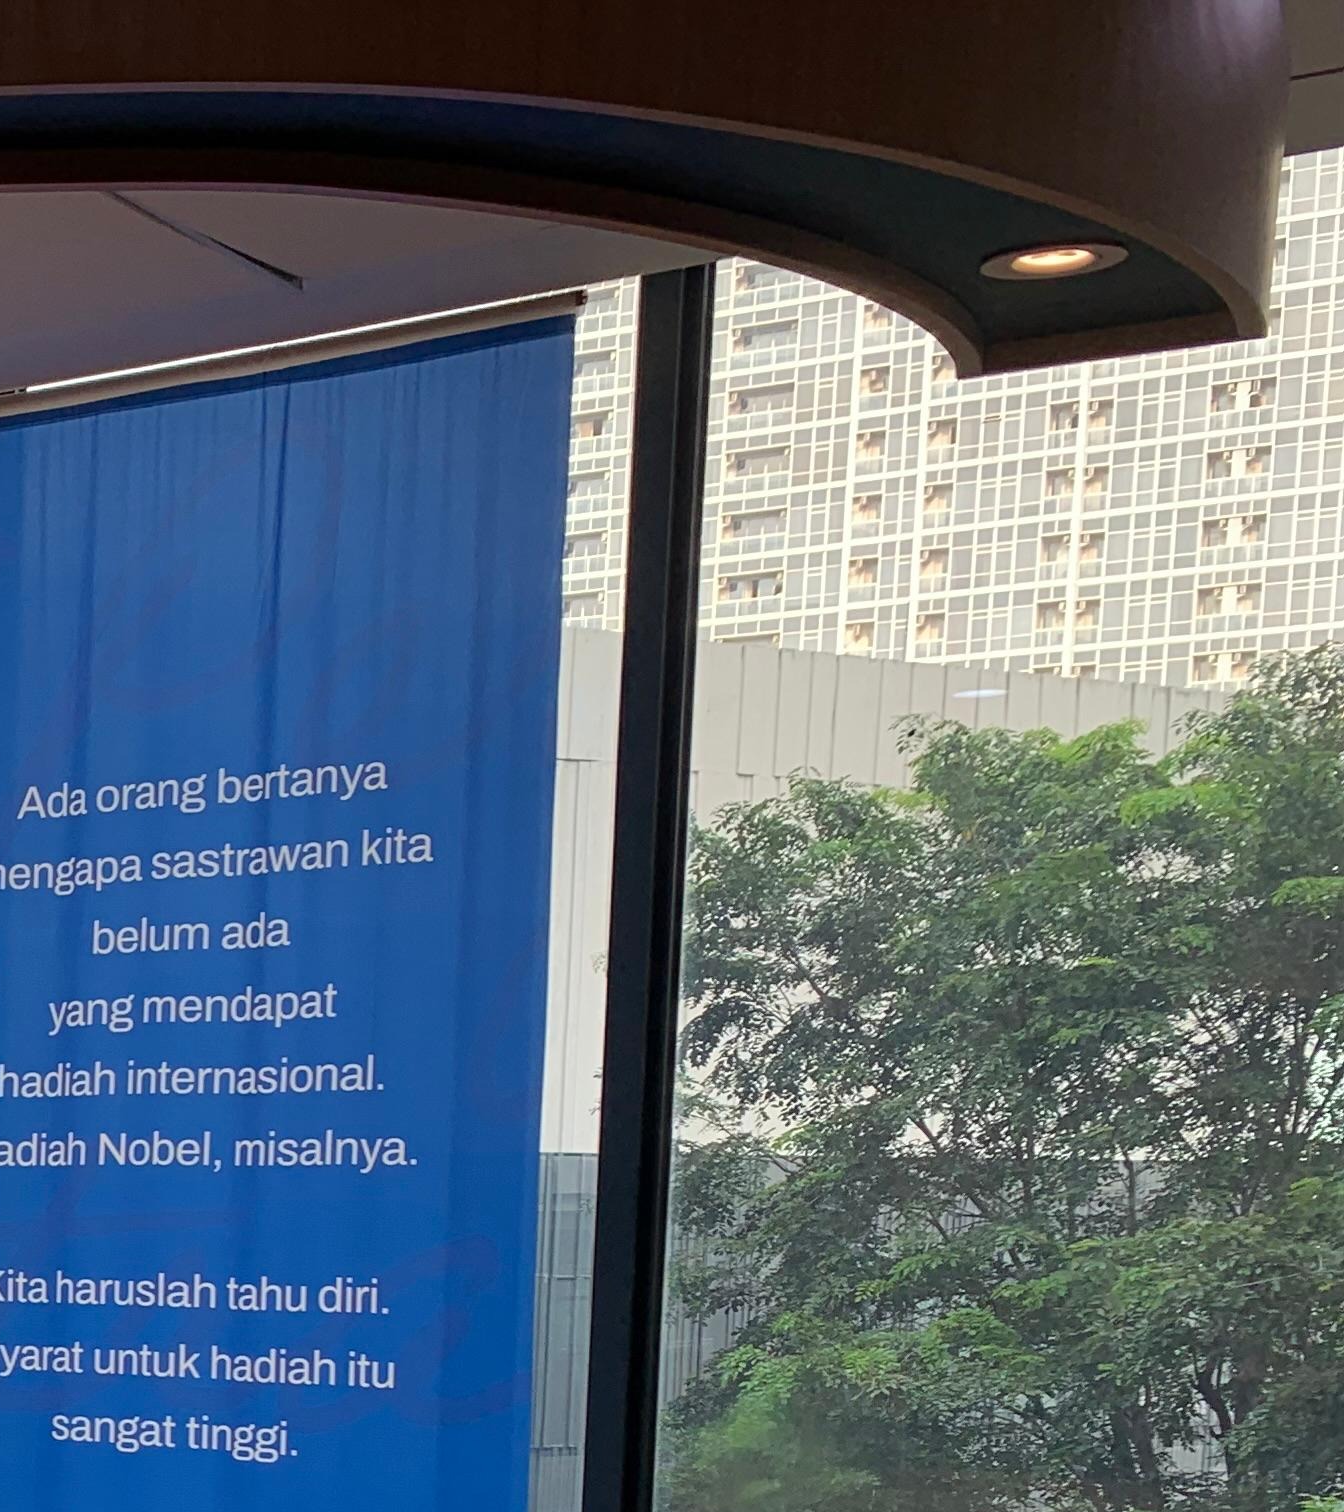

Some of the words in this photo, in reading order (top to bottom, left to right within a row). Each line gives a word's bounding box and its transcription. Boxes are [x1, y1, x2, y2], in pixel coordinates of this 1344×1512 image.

[16, 782, 88, 820] Ada
[96, 773, 207, 814] orang
[217, 761, 388, 804] bertanya
[151, 839, 349, 880] sastrawan
[361, 827, 434, 866] kita
[92, 916, 210, 955] belum
[221, 911, 291, 950] ada
[48, 994, 135, 1036] yang
[142, 983, 338, 1028] mendapat
[127, 1054, 384, 1095] internasional.
[98, 1130, 222, 1173] Nobel,
[234, 1129, 418, 1174] misalnya.
[55, 1270, 217, 1309] haruslah
[226, 1275, 307, 1312] tahu
[318, 1276, 389, 1315] diri.
[94, 1343, 201, 1379] untuk
[210, 1344, 336, 1386] hadiah
[348, 1350, 395, 1389] itu
[51, 1414, 177, 1453] sangat
[185, 1414, 298, 1463] tinggi.
